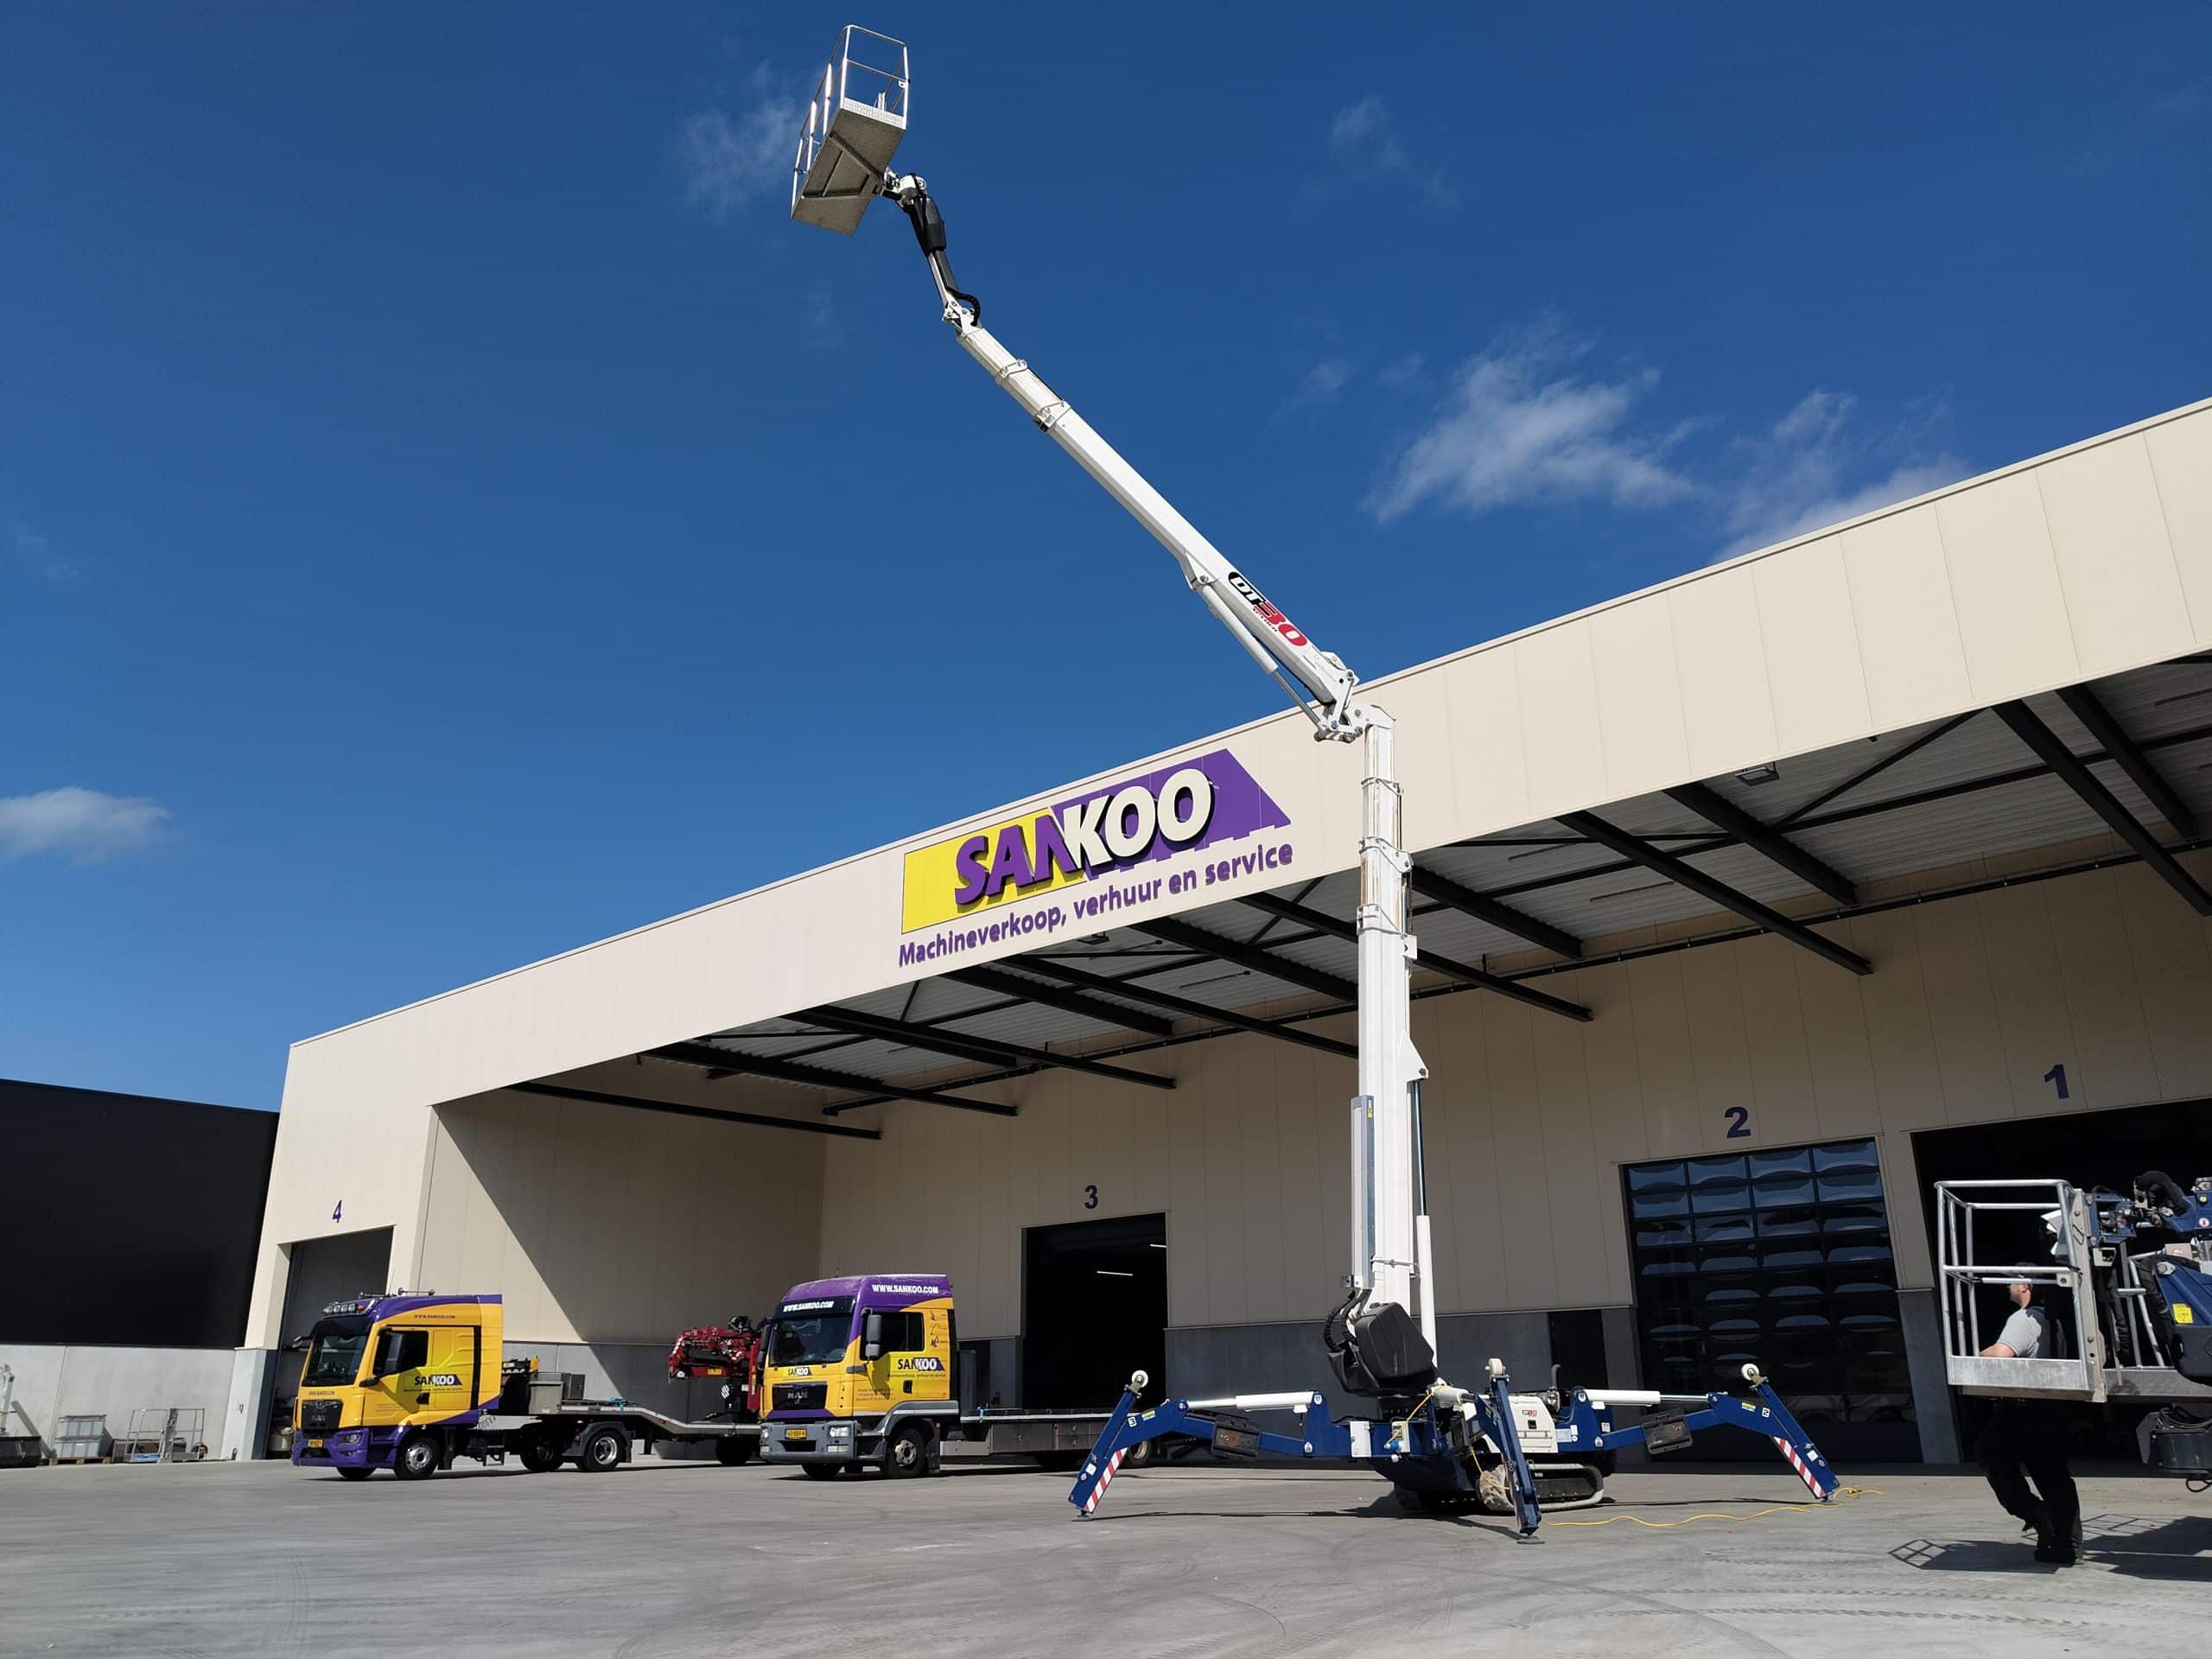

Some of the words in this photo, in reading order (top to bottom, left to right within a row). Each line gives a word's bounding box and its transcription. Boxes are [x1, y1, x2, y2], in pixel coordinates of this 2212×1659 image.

[954, 768, 1213, 906] SANKOO
[899, 906, 1066, 967] Machineverkoop,
[1073, 878, 1161, 918] verhuur
[1169, 869, 1197, 893] en
[1205, 842, 1293, 885] service
[2044, 1064, 2069, 1099] 1
[1725, 1107, 1751, 1139] 2
[1084, 1185, 1098, 1210] 3
[332, 1199, 341, 1223] 4
[872, 1284, 939, 1294] WWW.SANKOO.COM
[898, 1358, 938, 1370] SANKOO
[415, 1375, 454, 1385] SANKOO
